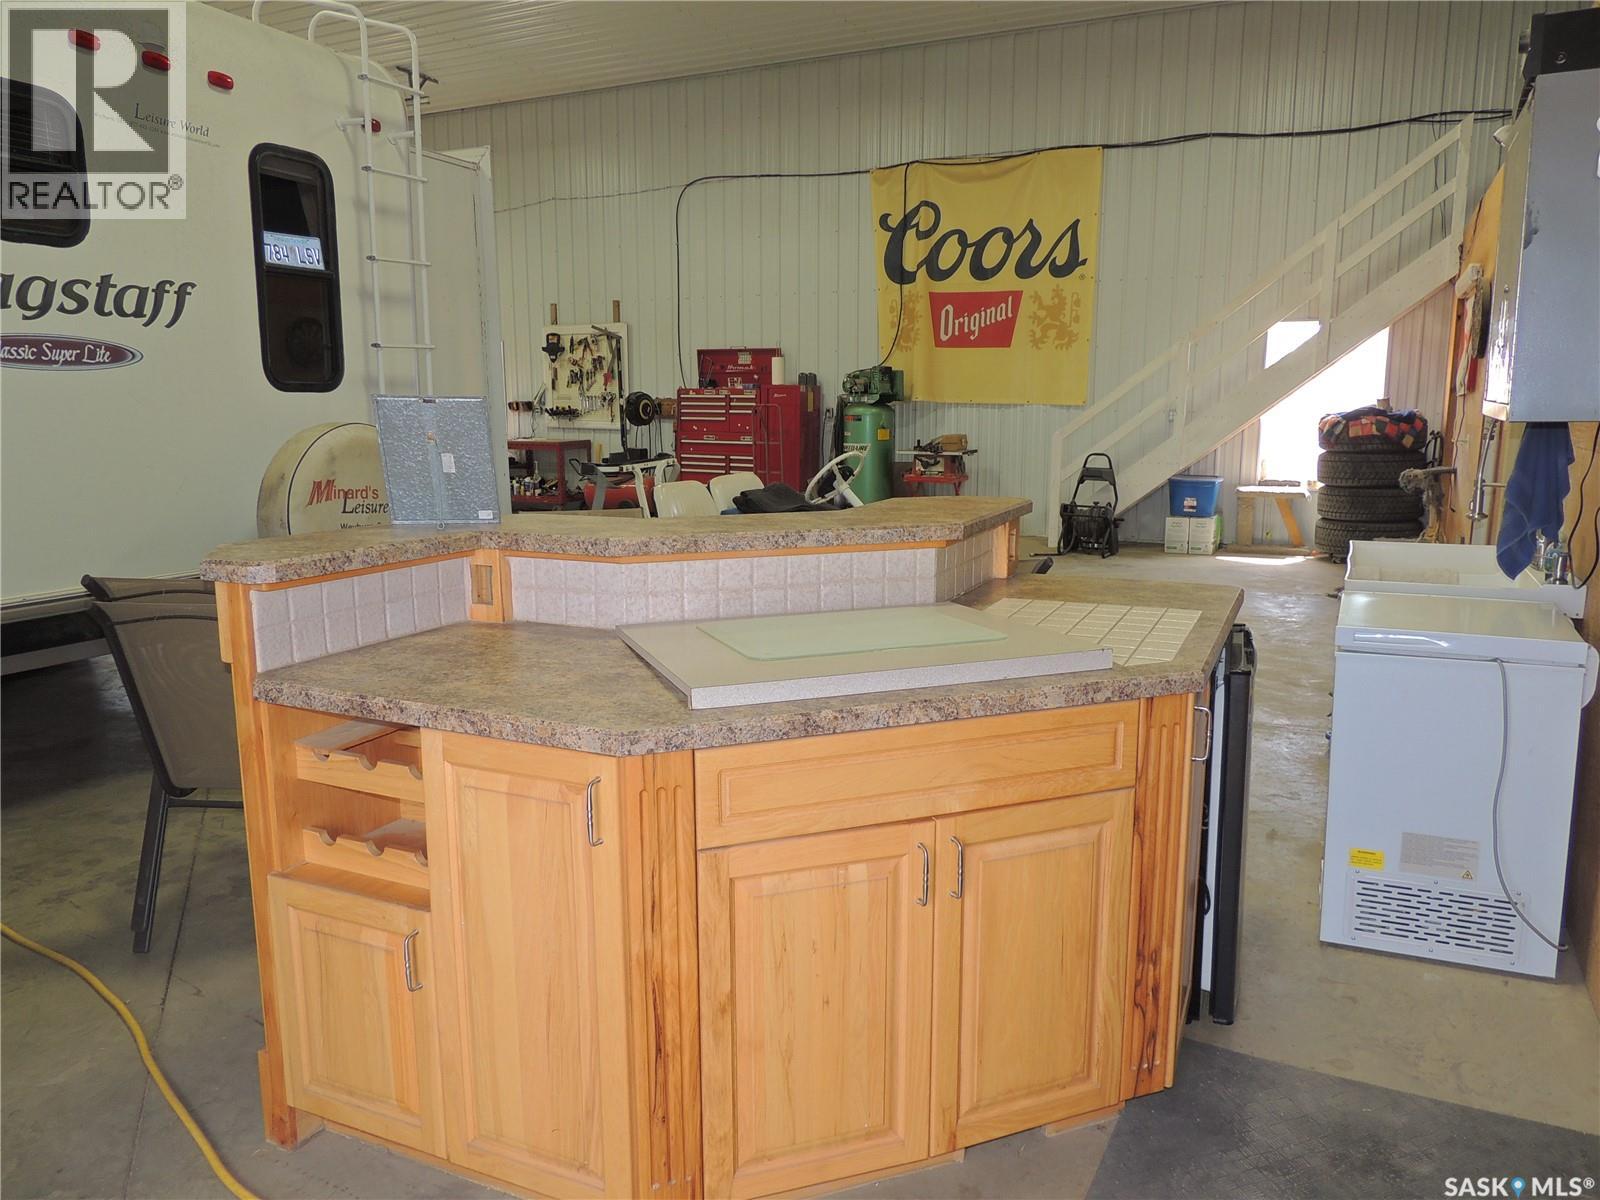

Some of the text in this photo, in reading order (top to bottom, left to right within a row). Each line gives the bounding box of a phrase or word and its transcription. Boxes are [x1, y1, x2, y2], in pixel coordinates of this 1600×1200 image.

[134, 102, 177, 129] Leisure
[180, 118, 209, 138] World
[264, 242, 290, 263] 784
[879, 200, 1088, 285] Coors
[939, 296, 1014, 342] Original
[41, 342, 80, 366] Super
[82, 344, 112, 363] Lite
[304, 478, 380, 508] Minard's
[341, 490, 390, 514] Leisure
